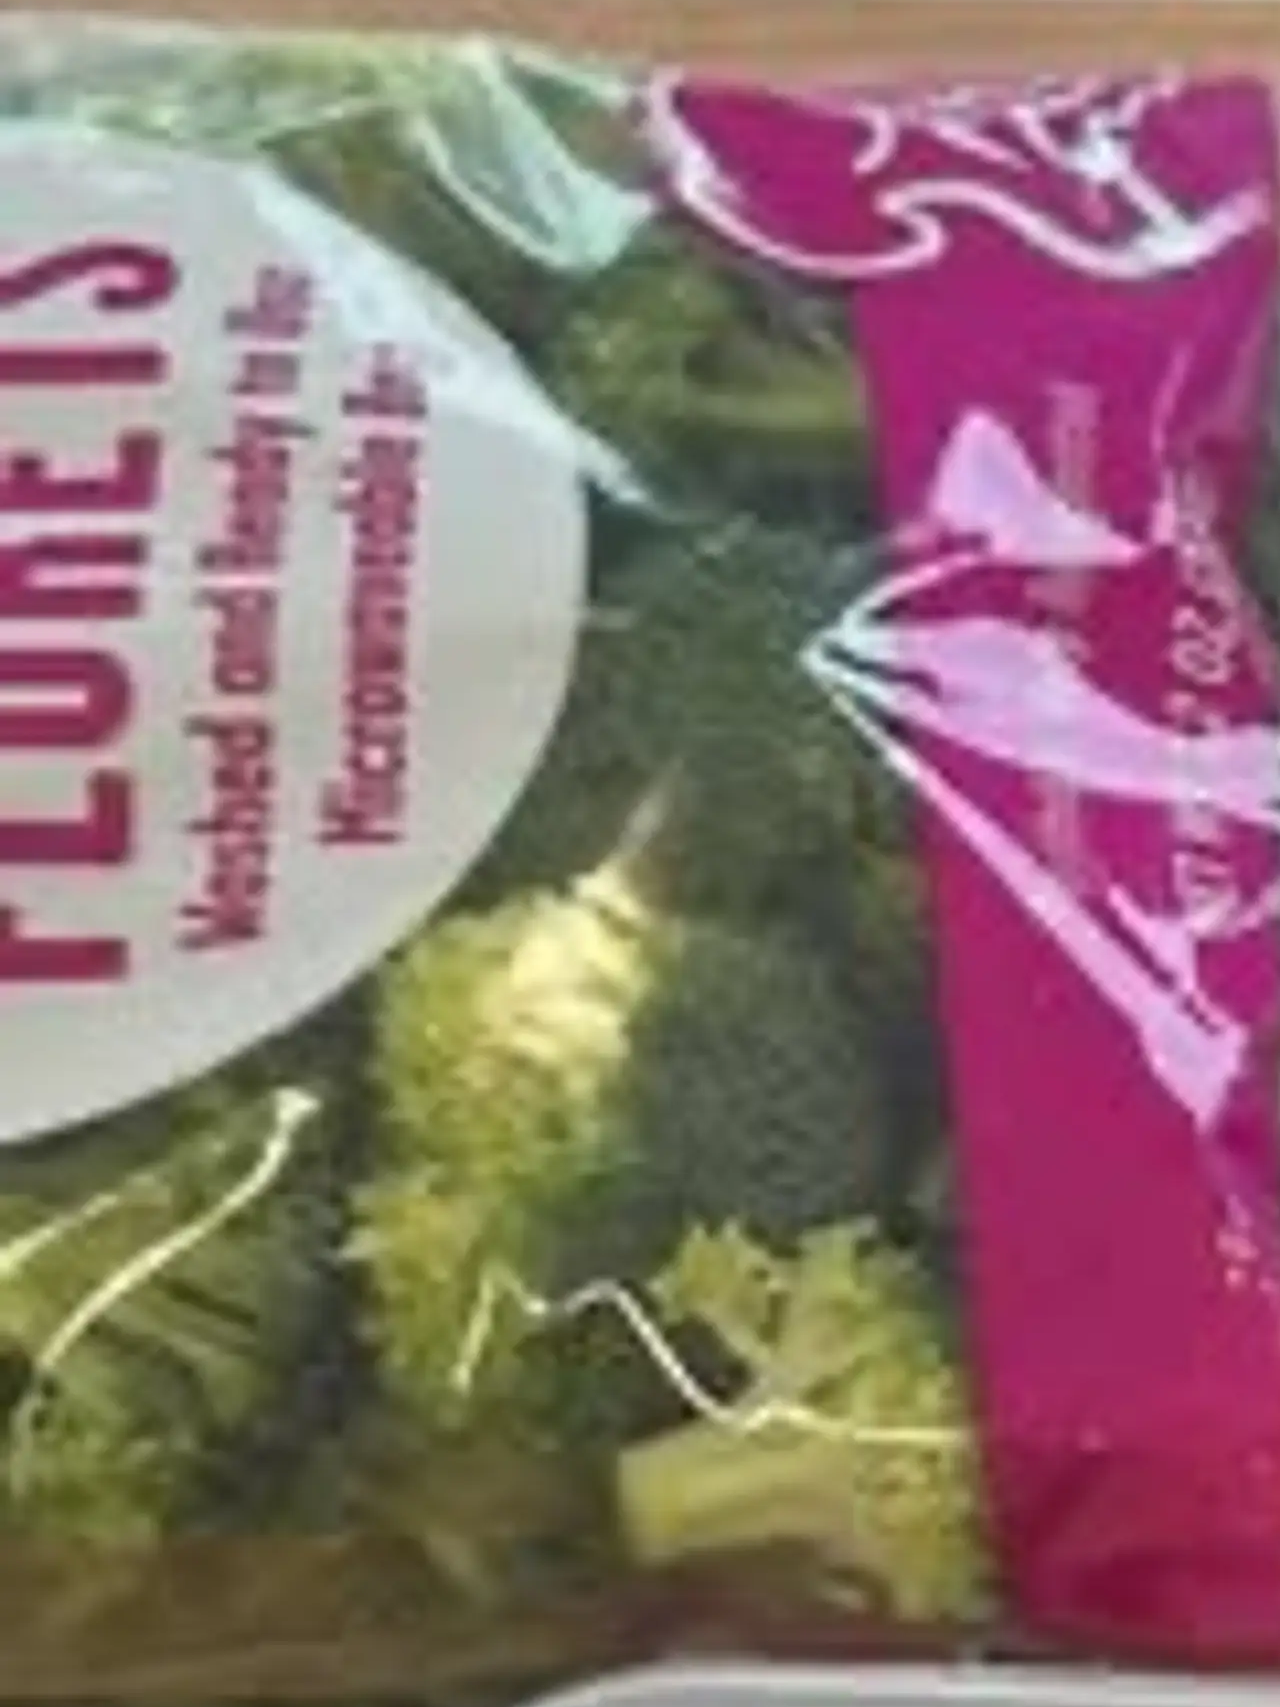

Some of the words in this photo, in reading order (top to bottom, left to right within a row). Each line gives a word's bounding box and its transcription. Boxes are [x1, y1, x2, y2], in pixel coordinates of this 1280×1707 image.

[226, 353, 302, 394] to
[197, 416, 316, 572] Ready
[197, 587, 278, 695] and
[177, 716, 274, 952] Washed
